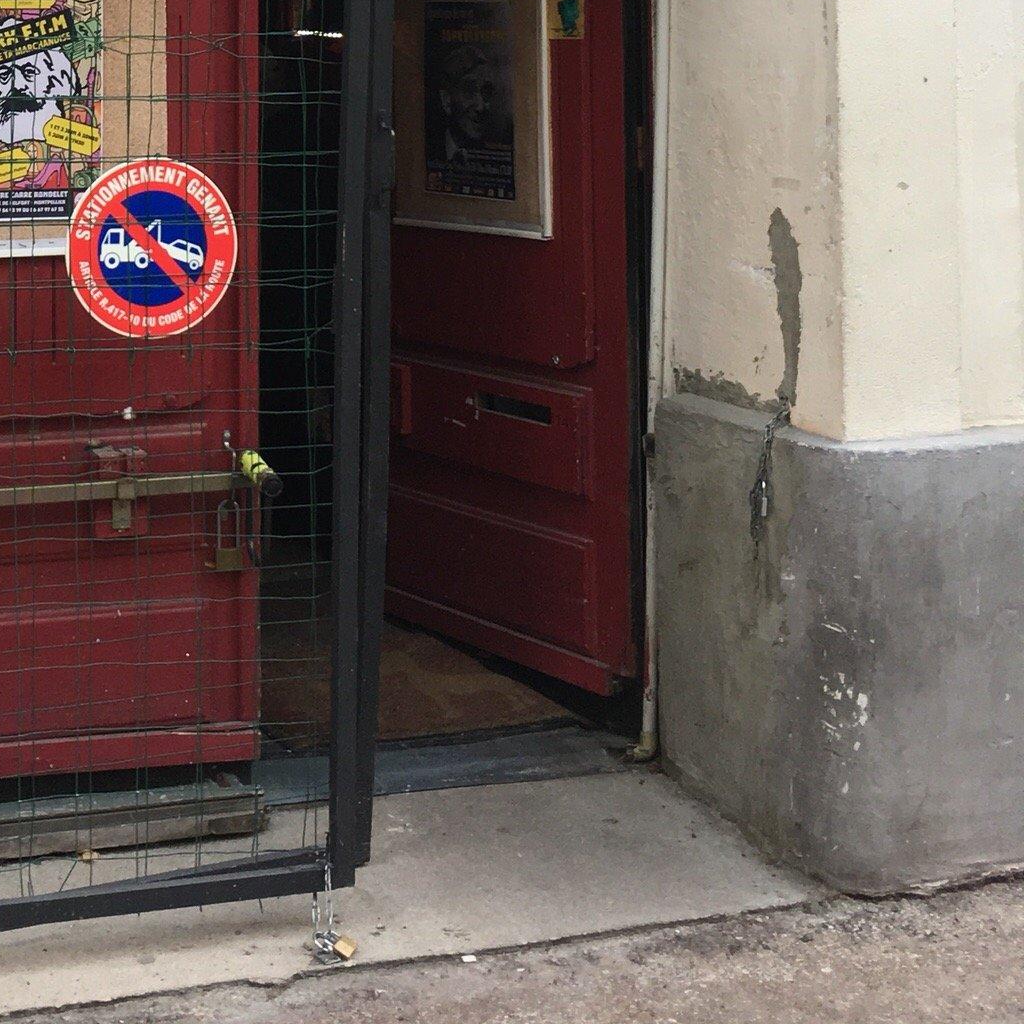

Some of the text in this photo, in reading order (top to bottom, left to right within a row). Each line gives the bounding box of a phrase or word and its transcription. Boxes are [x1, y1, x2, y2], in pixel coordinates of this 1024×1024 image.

[14, 32, 71, 56] MARCHANDISE
[21, 14, 69, 41] F.T.M
[76, 165, 230, 241] STATIONNEMENT GENANT
[79, 260, 103, 301] ARTICLE
[142, 316, 155, 326] DU
[158, 311, 185, 326] CODE
[184, 301, 199, 315] DE
[196, 287, 210, 305] LA
[205, 258, 226, 292] ROUTE
